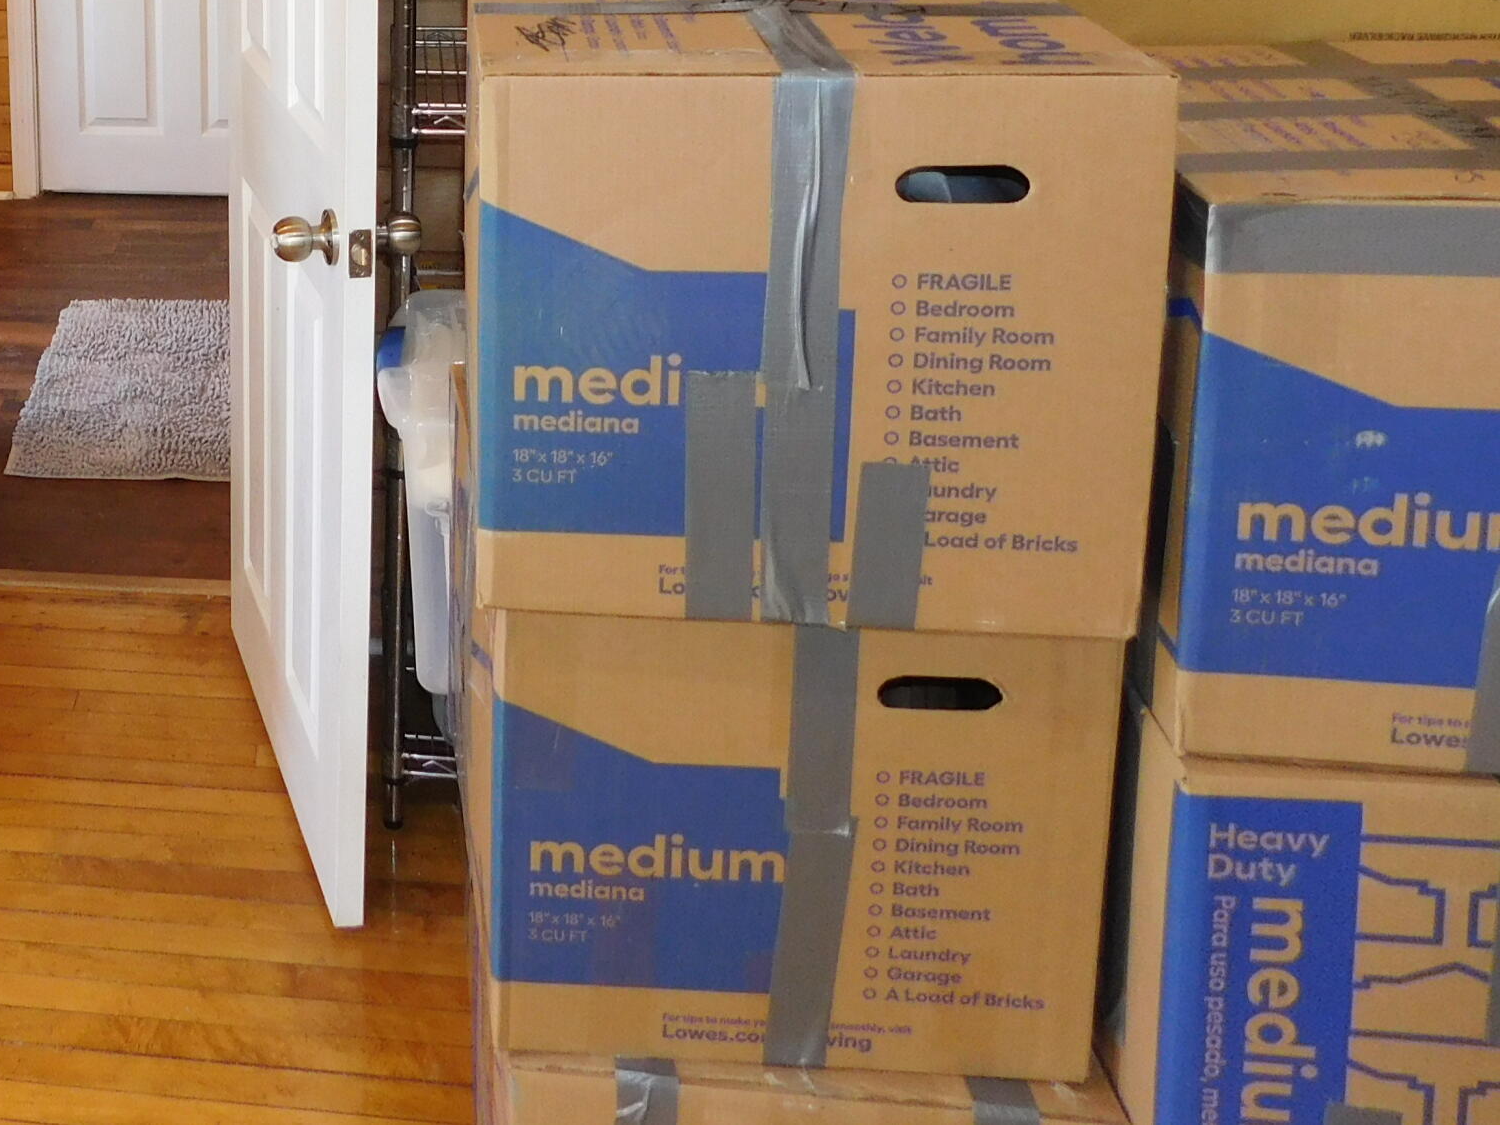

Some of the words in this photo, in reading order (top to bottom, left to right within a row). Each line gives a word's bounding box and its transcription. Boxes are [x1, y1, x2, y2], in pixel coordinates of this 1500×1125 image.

[970, 18, 1093, 65] hom
[916, 273, 1012, 291] FRAGILE
[915, 300, 1014, 318] Bedroom
[914, 327, 985, 347] Family
[992, 328, 1054, 345] Room
[913, 352, 983, 373] Dining
[989, 354, 1052, 371] Room
[513, 353, 683, 406] medi
[911, 378, 996, 397] Kitchen
[513, 410, 640, 434] mediana
[910, 404, 962, 422] Bath
[908, 431, 1020, 449] Basement
[512, 470, 521, 482] 3
[526, 469, 551, 483] CU
[557, 470, 576, 484] FT
[928, 483, 997, 502] undry
[924, 509, 988, 527] arage
[924, 531, 979, 548] Load
[984, 533, 1008, 549] of
[1012, 534, 1078, 553] Bricks
[659, 564, 678, 575] For
[1234, 549, 1379, 576] mediana
[1230, 610, 1241, 623] 3
[1245, 610, 1275, 624] CU
[1281, 611, 1303, 626] FT
[1392, 712, 1413, 724] For
[899, 771, 986, 786] FRAGILE
[898, 793, 988, 809] Bedroom
[896, 815, 963, 834] Family
[967, 817, 1024, 833] Room
[895, 838, 959, 857] Dining
[964, 839, 1020, 855] Room
[1209, 823, 1330, 858] Heavy
[530, 833, 786, 883] medium
[894, 860, 971, 876] Kitchen
[1207, 854, 1297, 887] Duty
[529, 879, 645, 901] mediana
[892, 882, 940, 897] Bath
[891, 903, 991, 922] Basement
[1211, 894, 1237, 947] Para
[528, 928, 538, 940] 3
[541, 929, 565, 942] CU
[569, 930, 588, 942] FT
[889, 925, 938, 940] Attic
[888, 947, 972, 965] Laundry
[887, 966, 963, 986] Garage
[1209, 952, 1230, 992] uso
[885, 988, 899, 1002] A
[905, 988, 955, 1005] Load
[960, 990, 980, 1006] of
[984, 992, 1045, 1011] Bricks
[1240, 897, 1318, 1124] mediu
[1201, 996, 1228, 1082] pesado,
[1201, 1088, 1219, 1125] me
